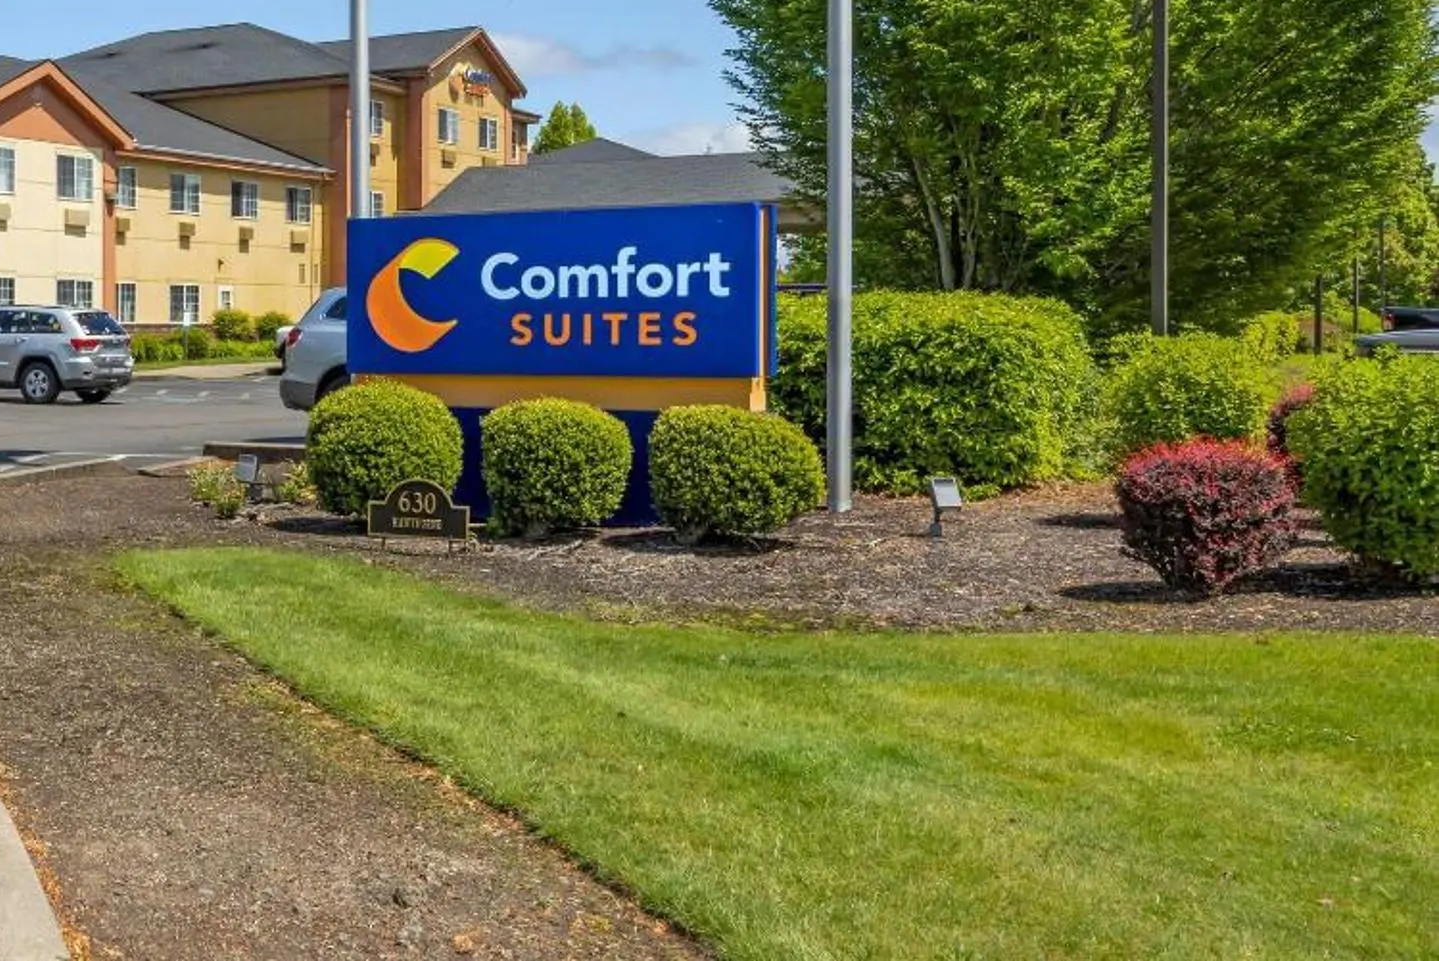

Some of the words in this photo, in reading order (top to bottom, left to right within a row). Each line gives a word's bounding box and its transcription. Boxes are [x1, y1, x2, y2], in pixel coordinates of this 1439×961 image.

[480, 245, 731, 301] Comfort
[510, 311, 698, 346] SUITES
[398, 490, 436, 515] 630
